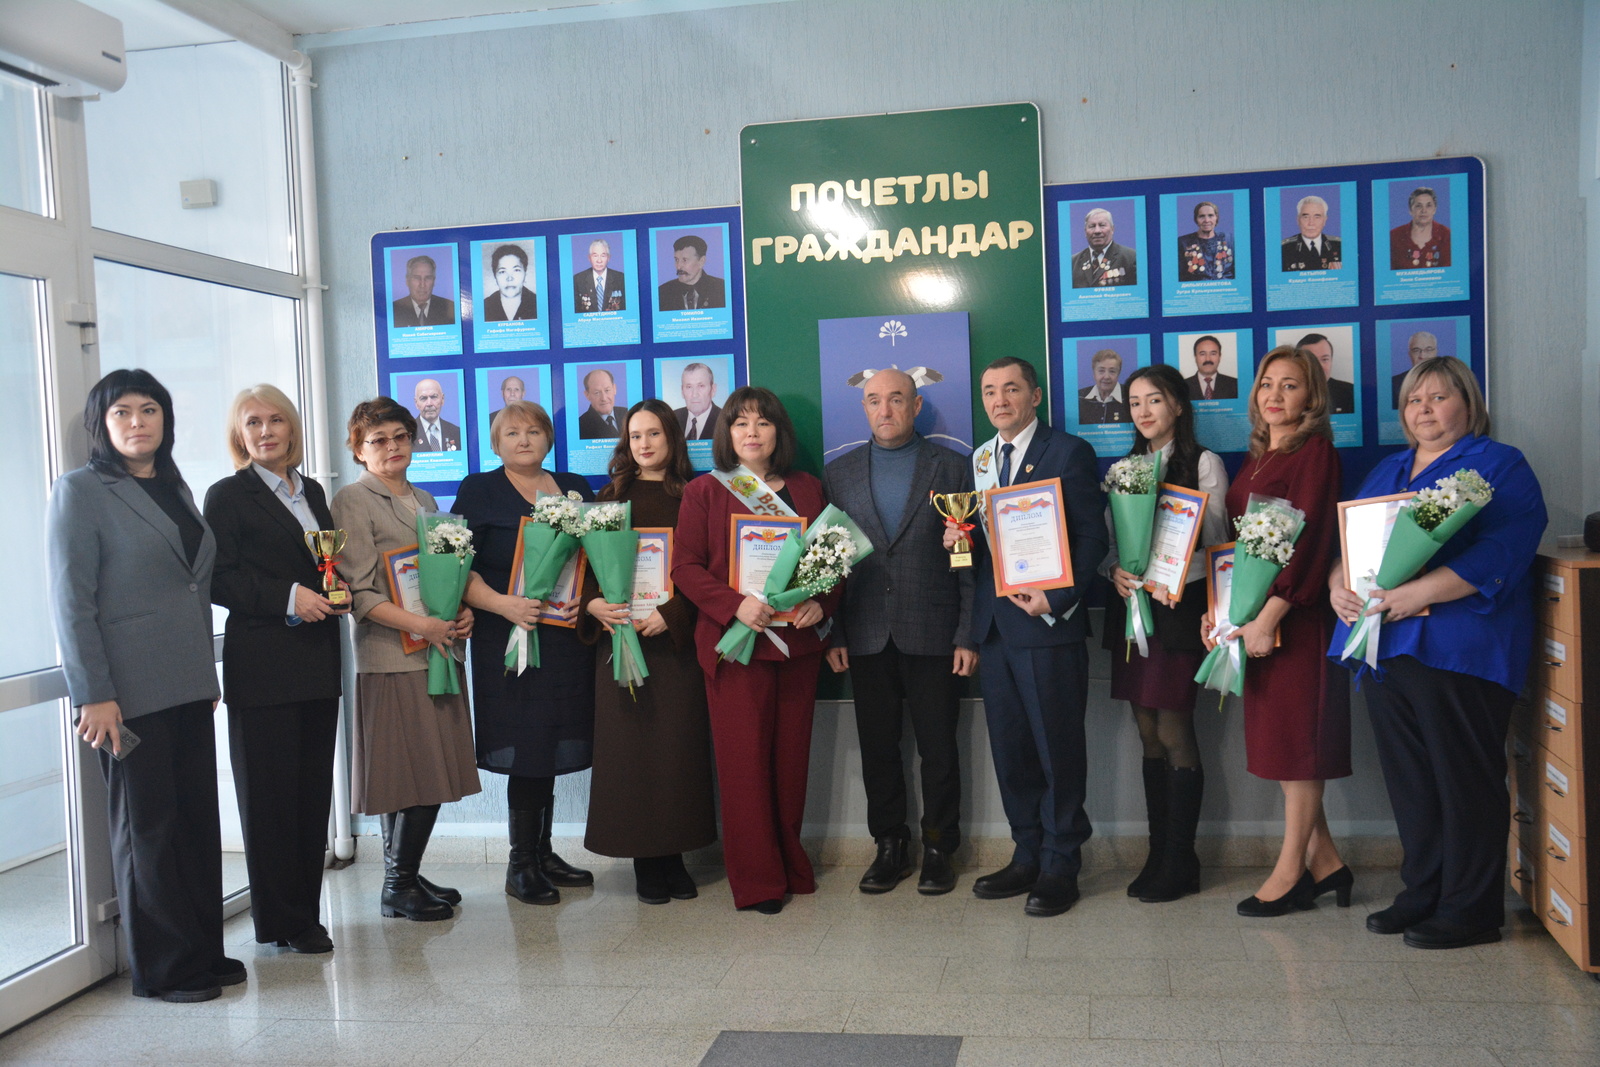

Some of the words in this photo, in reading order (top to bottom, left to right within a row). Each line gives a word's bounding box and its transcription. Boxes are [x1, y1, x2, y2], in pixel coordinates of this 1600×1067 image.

[790, 169, 989, 212] ПОЧЕТЛЫ
[752, 220, 1034, 266] ГРАЖДАНДАР
[1010, 511, 1043, 523] ДИПЛОМ
